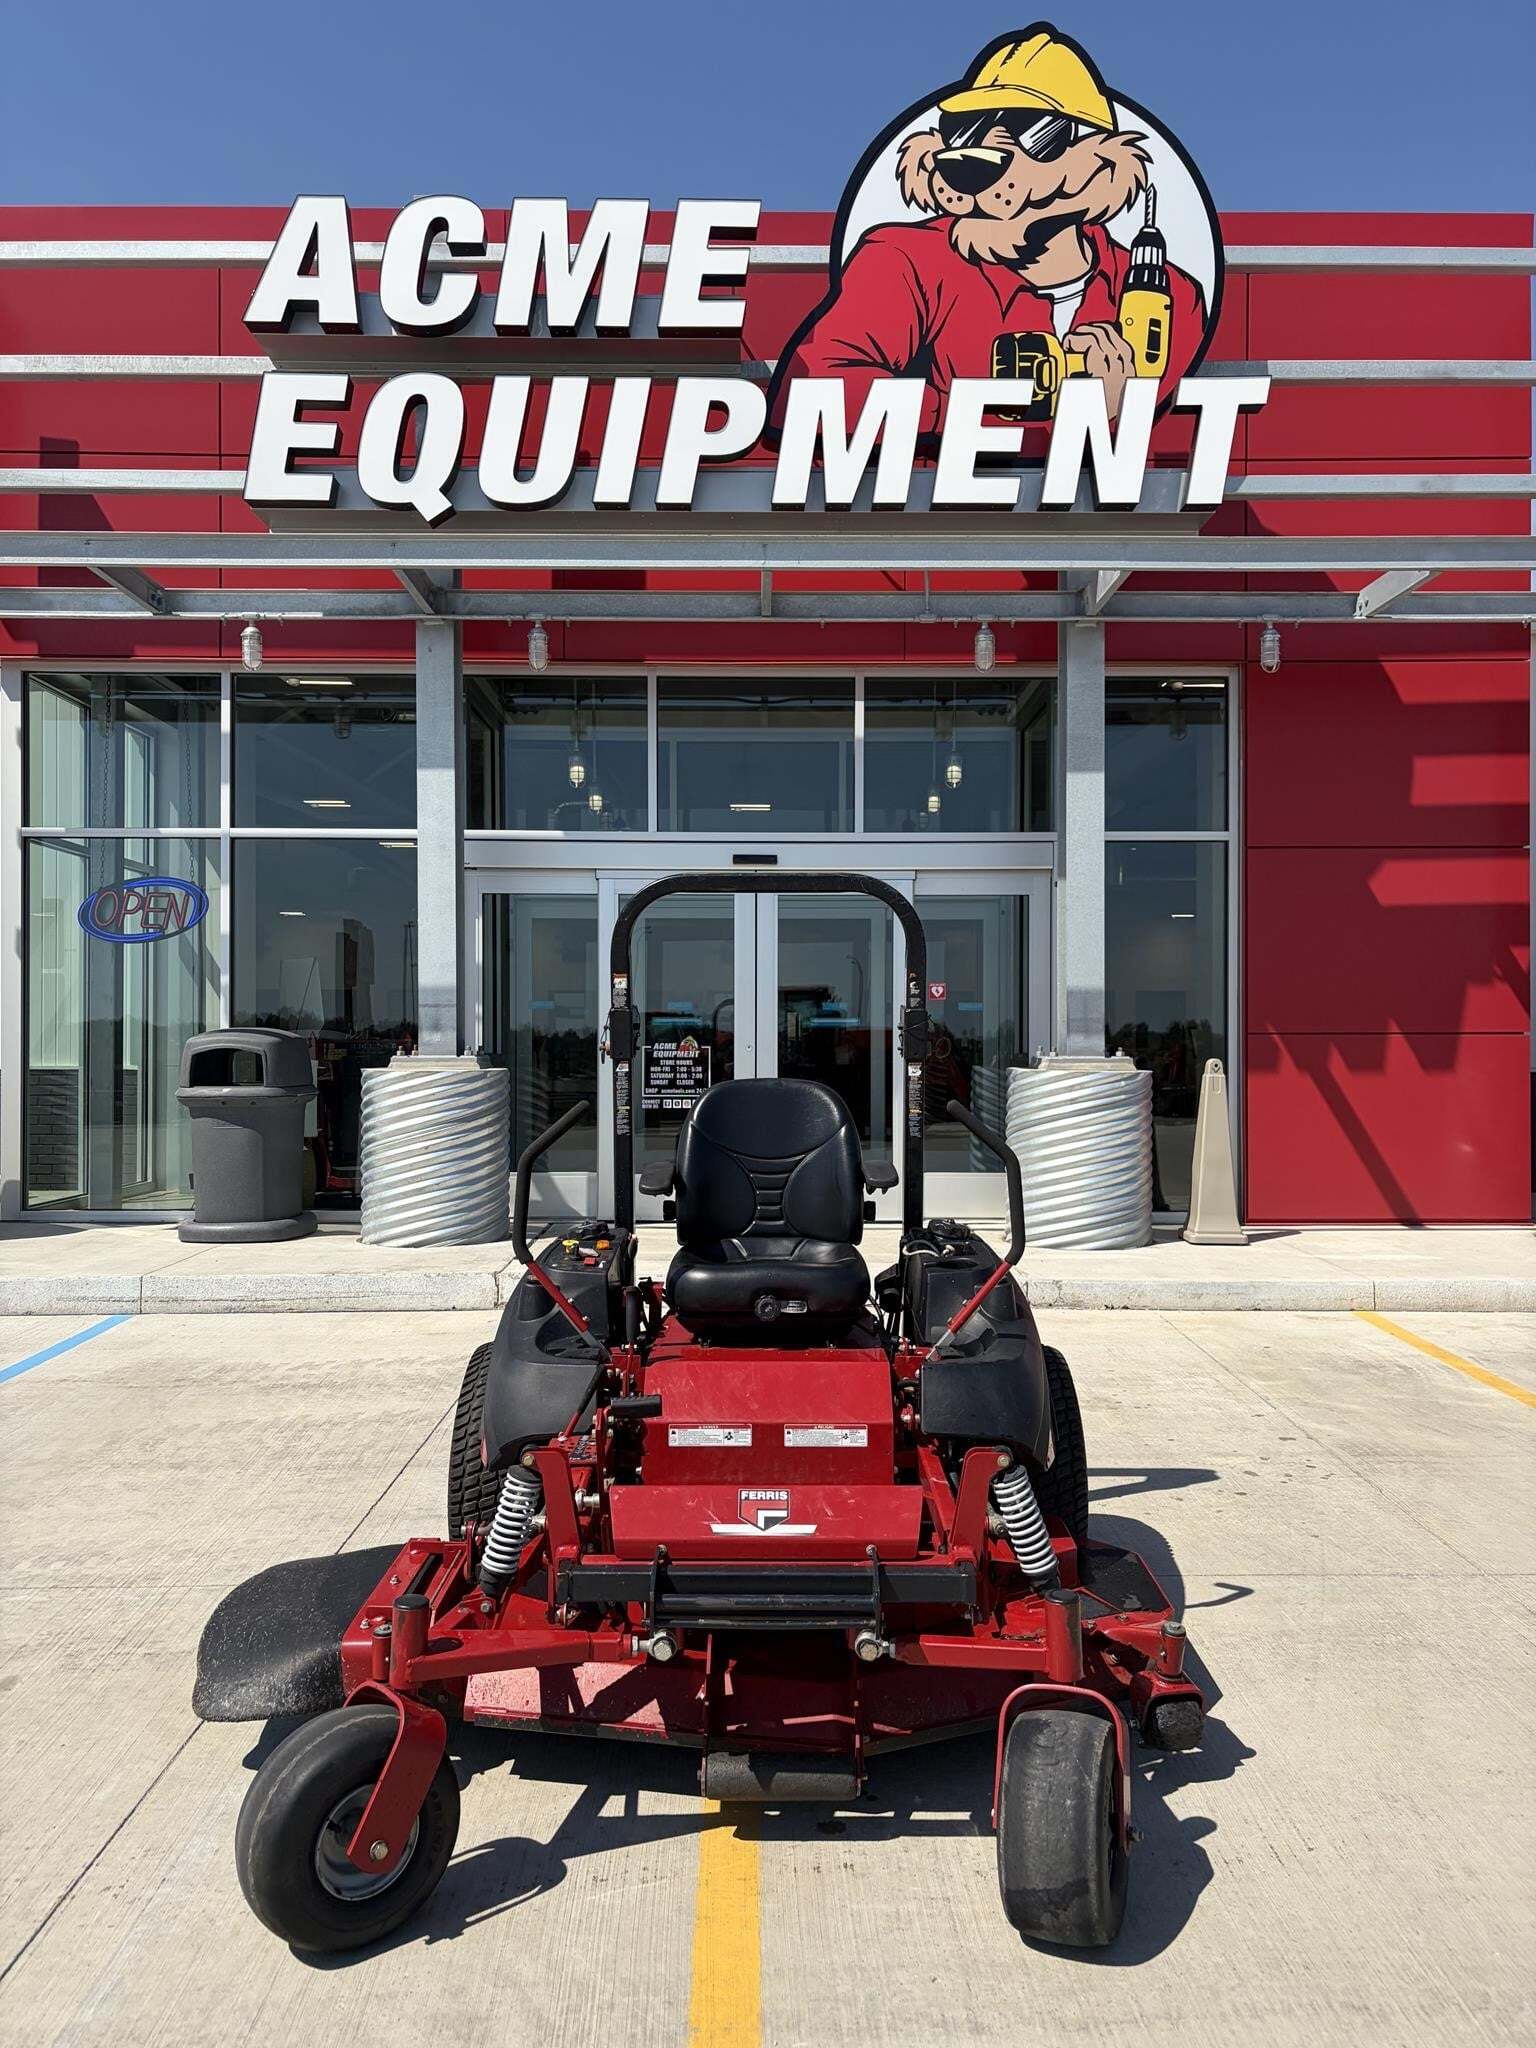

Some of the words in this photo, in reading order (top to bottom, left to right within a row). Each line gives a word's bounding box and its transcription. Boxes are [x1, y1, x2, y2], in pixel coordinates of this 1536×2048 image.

[244, 195, 763, 335] ACME
[243, 373, 1272, 526] EQUIPMENT
[94, 888, 190, 930] OPEN
[653, 1042, 677, 1050] ACME
[653, 1050, 700, 1058] EQUIPMENT
[741, 1490, 788, 1501] FERRIS
